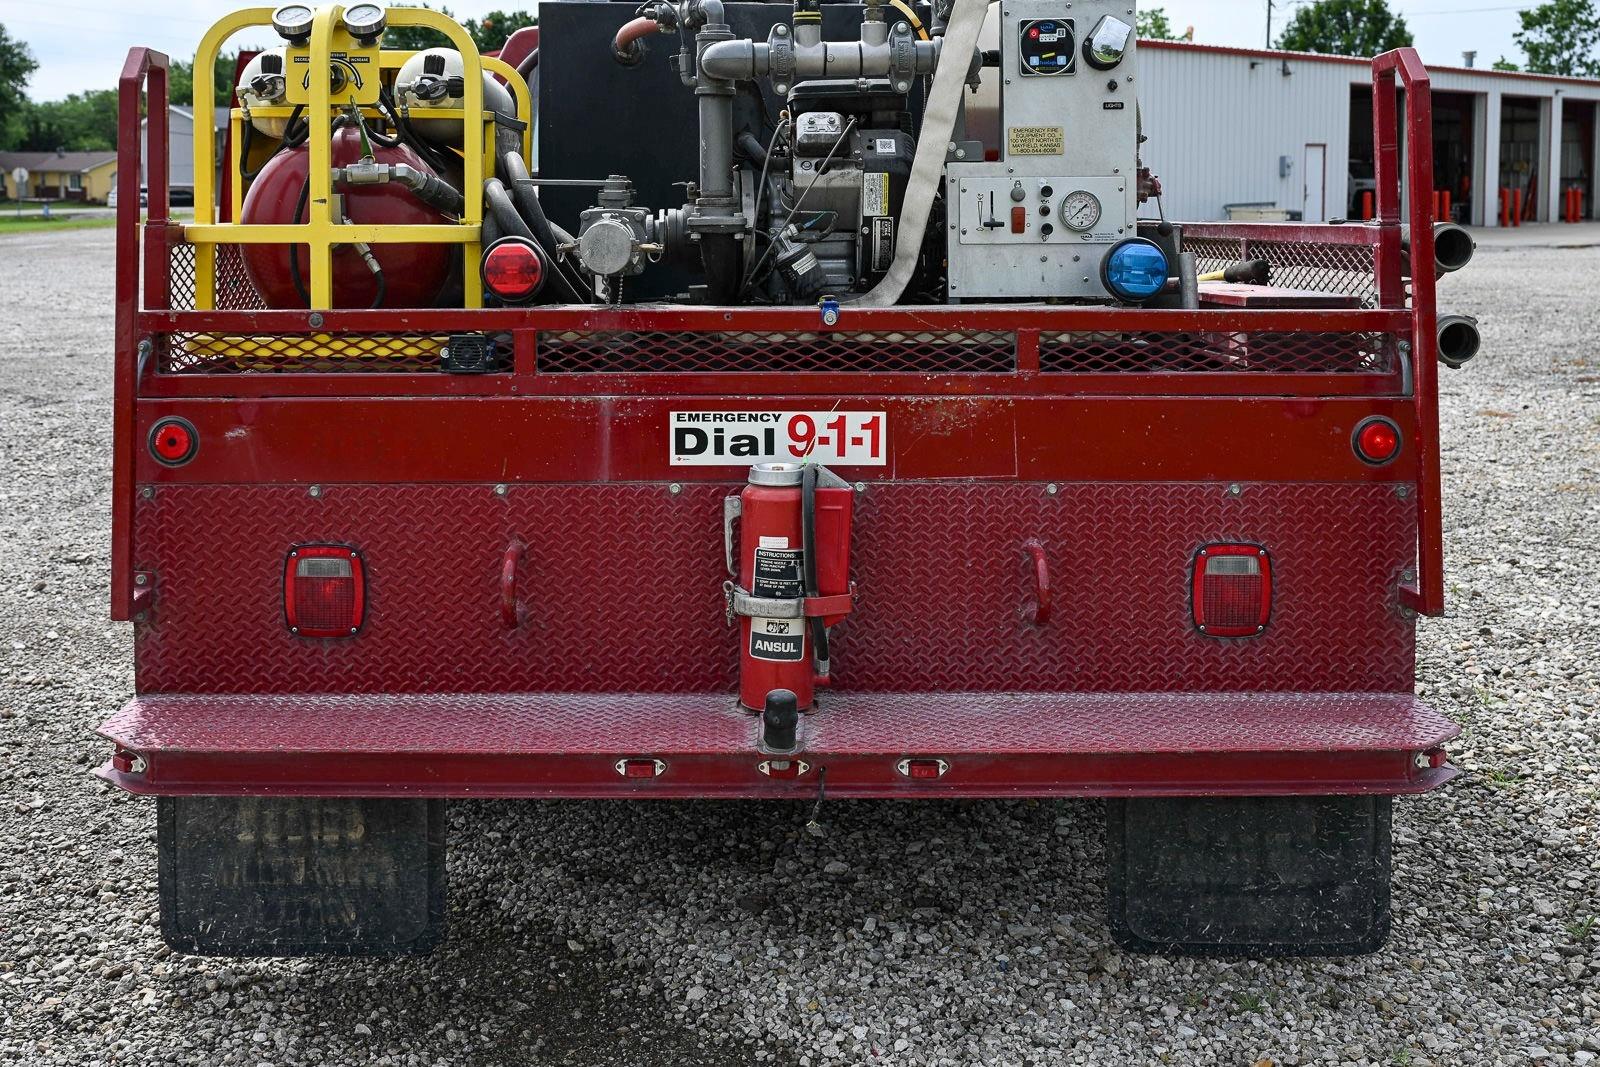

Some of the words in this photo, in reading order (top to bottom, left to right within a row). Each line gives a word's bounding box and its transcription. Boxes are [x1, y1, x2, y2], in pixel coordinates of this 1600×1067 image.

[676, 413, 782, 423] EMERGENCY
[674, 427, 775, 457] Dial
[787, 414, 880, 458] 9-1-1
[755, 640, 797, 653] ANSUL
